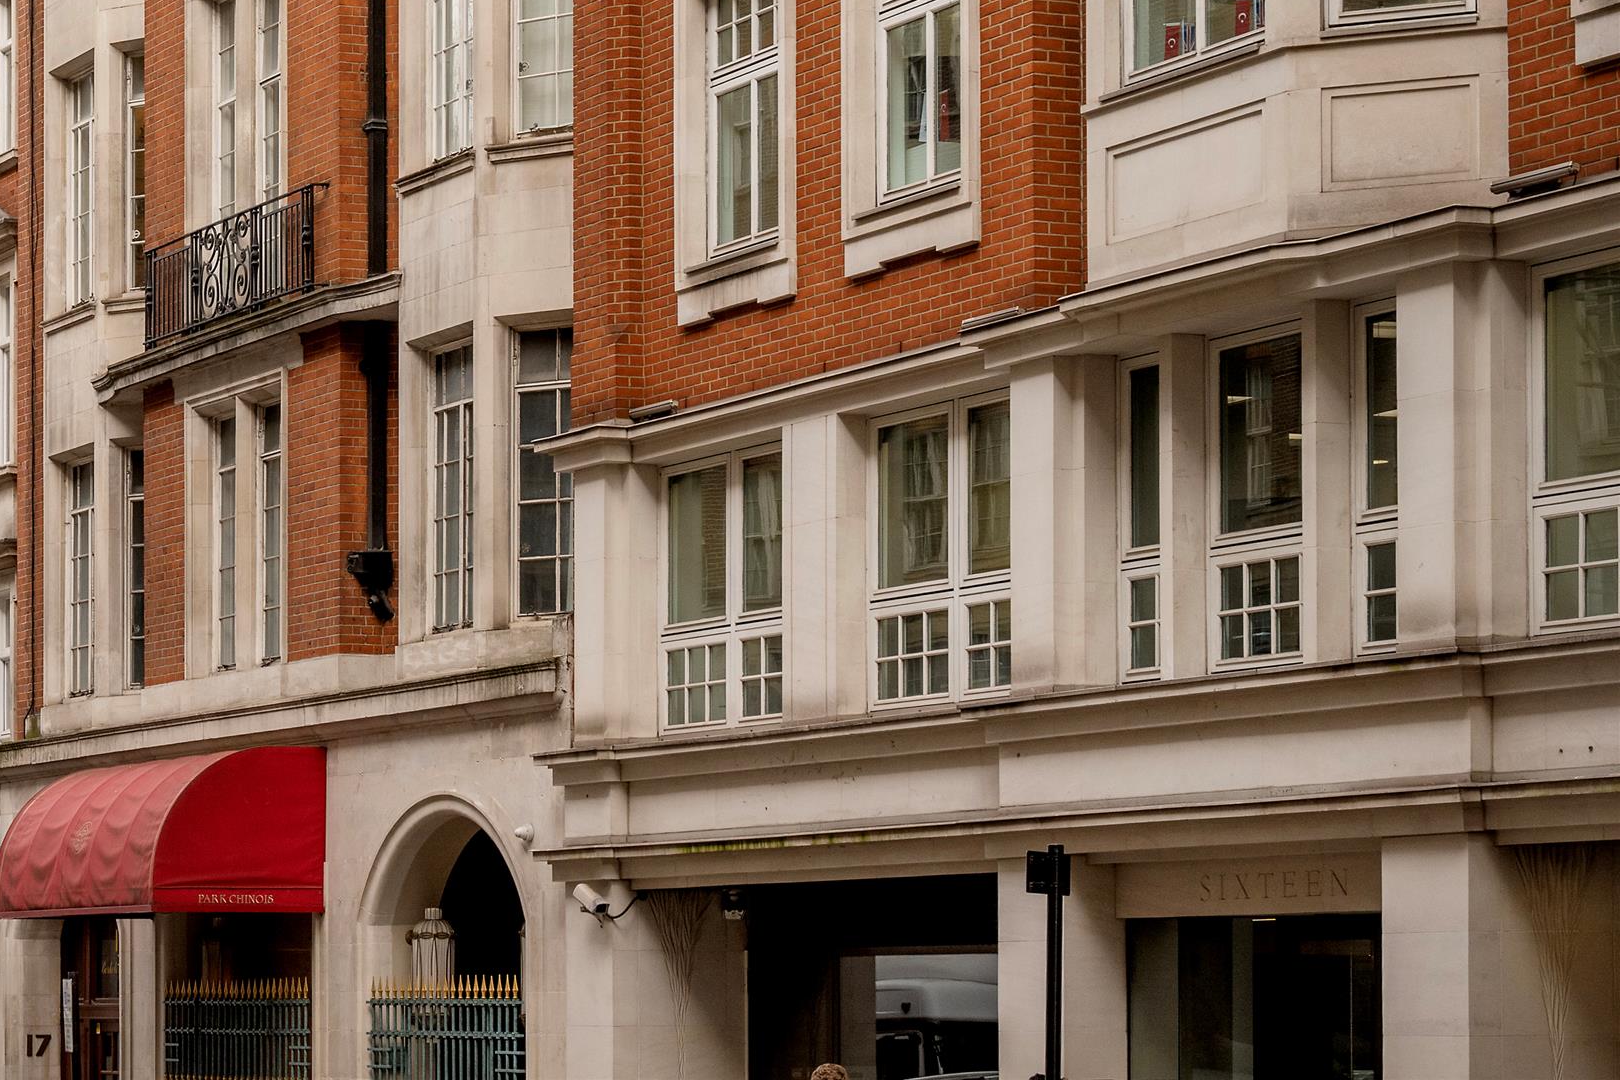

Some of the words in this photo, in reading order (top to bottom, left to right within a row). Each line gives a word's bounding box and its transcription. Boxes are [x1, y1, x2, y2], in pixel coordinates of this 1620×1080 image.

[1199, 869, 1348, 902] SIXTEEN
[198, 894, 227, 904] PARK
[229, 894, 274, 904] CHINOIS
[26, 1034, 52, 1057] 17
